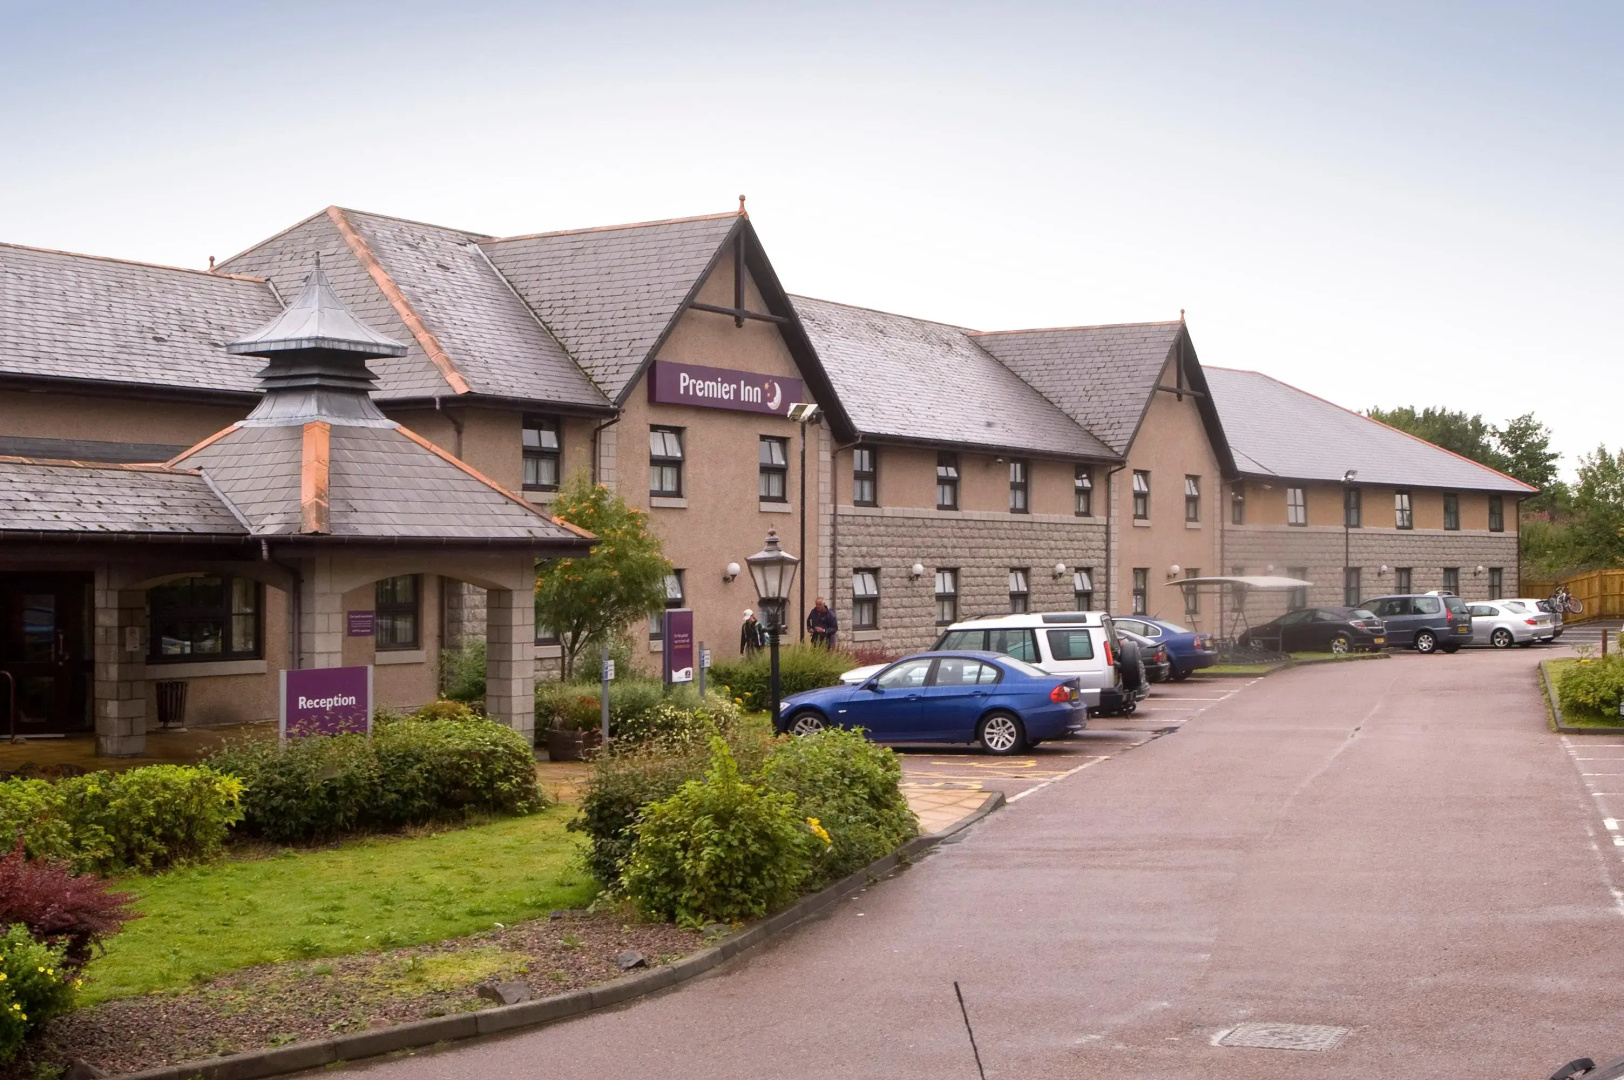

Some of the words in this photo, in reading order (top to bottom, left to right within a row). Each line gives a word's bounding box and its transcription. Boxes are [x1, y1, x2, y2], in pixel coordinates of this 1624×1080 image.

[680, 373, 737, 400] Premier
[740, 380, 761, 403] Inn
[298, 693, 356, 711] Reception
